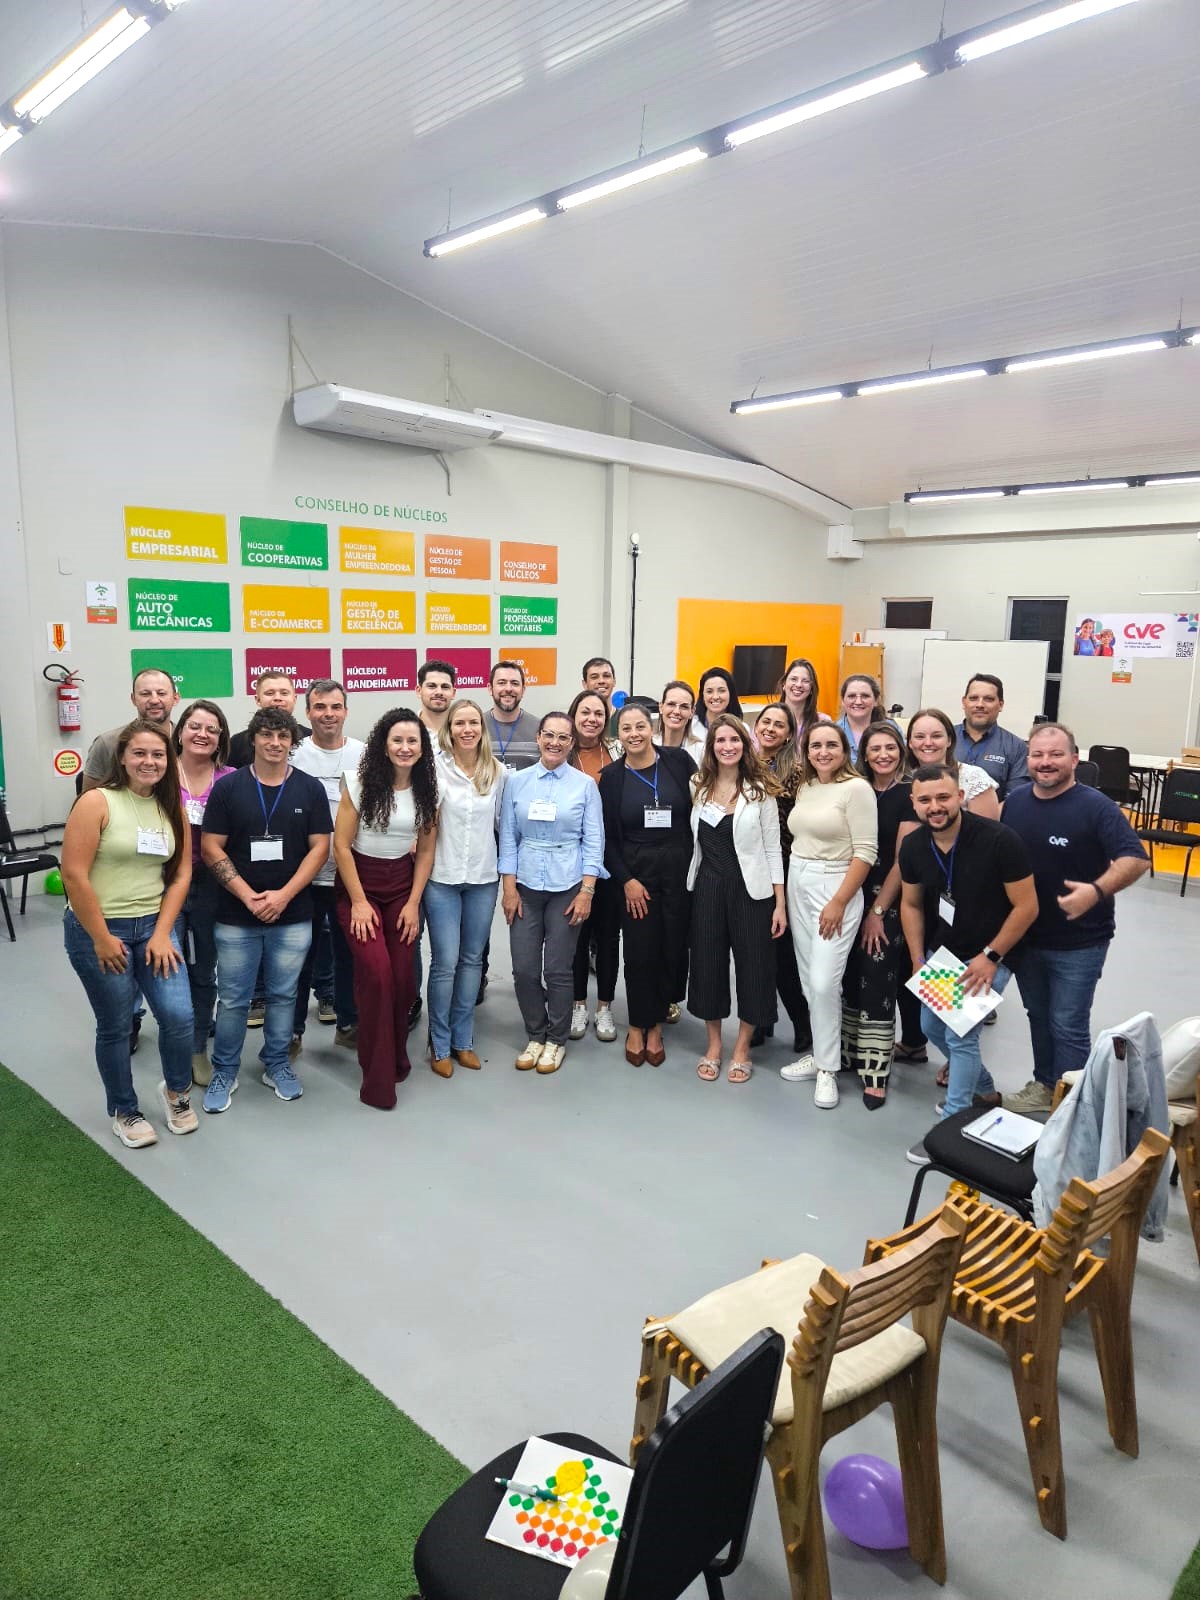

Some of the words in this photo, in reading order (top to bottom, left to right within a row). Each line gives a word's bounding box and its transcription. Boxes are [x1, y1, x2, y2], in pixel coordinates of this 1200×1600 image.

[294, 495, 369, 515] CONSELHO
[373, 504, 390, 517] DE
[393, 505, 448, 523] NÚCLEOS
[130, 526, 171, 539] NÚCLEO
[131, 541, 219, 559] EMPRESARIAL
[247, 541, 274, 551] NÚCLEO
[429, 546, 454, 556] NÚCLEO
[454, 548, 463, 556] DE
[248, 552, 323, 567] COOPERATIVAS
[345, 551, 377, 561] MULHER
[429, 556, 453, 565] GESTÃO
[453, 558, 462, 566] DE
[345, 560, 411, 572] EMPREENDEDORA
[429, 566, 456, 575] PESSOAS
[503, 560, 538, 570] CONSELHO
[538, 562, 547, 571] DE
[503, 567, 540, 580] NÚCLEOS
[135, 591, 166, 601] NÚCLEO
[168, 593, 178, 601] DE
[136, 602, 173, 614] AUTO
[346, 608, 385, 619] GESTÃO
[387, 609, 400, 619] DE
[137, 613, 213, 628] MECÂNICAS
[250, 618, 324, 629] E-COMMERCE
[430, 613, 456, 623] JOVEM
[503, 614, 554, 624] PROFISSIONAIS
[346, 618, 404, 630] EXCELÊNCIA
[430, 622, 487, 632] EMPREENDEDOR
[285, 667, 297, 675] DE
[346, 666, 377, 676] NÚCLEO
[377, 667, 387, 675] DE
[347, 678, 409, 689] BANDEIRANTE
[457, 676, 484, 685] BONITA
